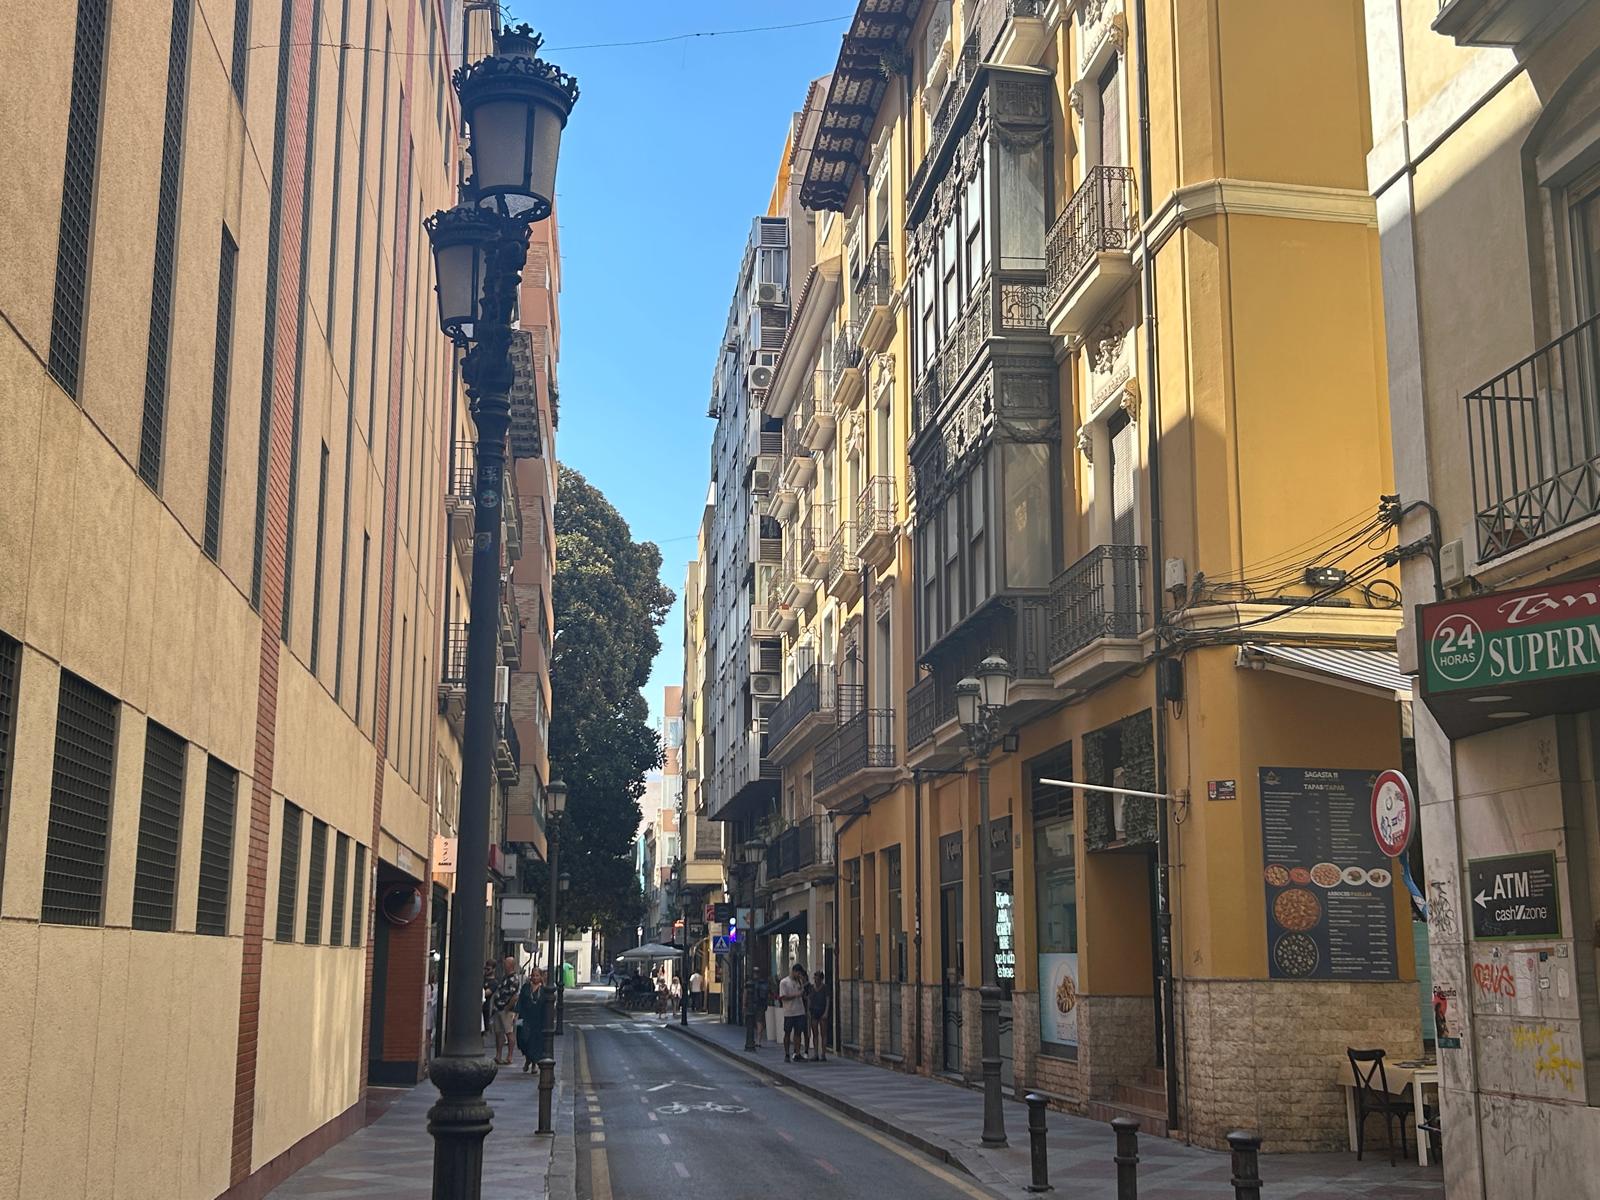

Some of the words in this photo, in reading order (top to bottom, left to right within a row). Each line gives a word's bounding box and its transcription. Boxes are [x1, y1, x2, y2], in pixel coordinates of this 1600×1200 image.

[1440, 624, 1476, 653] 24
[1440, 652, 1476, 666] HORAS
[1494, 872, 1530, 900] ATM
